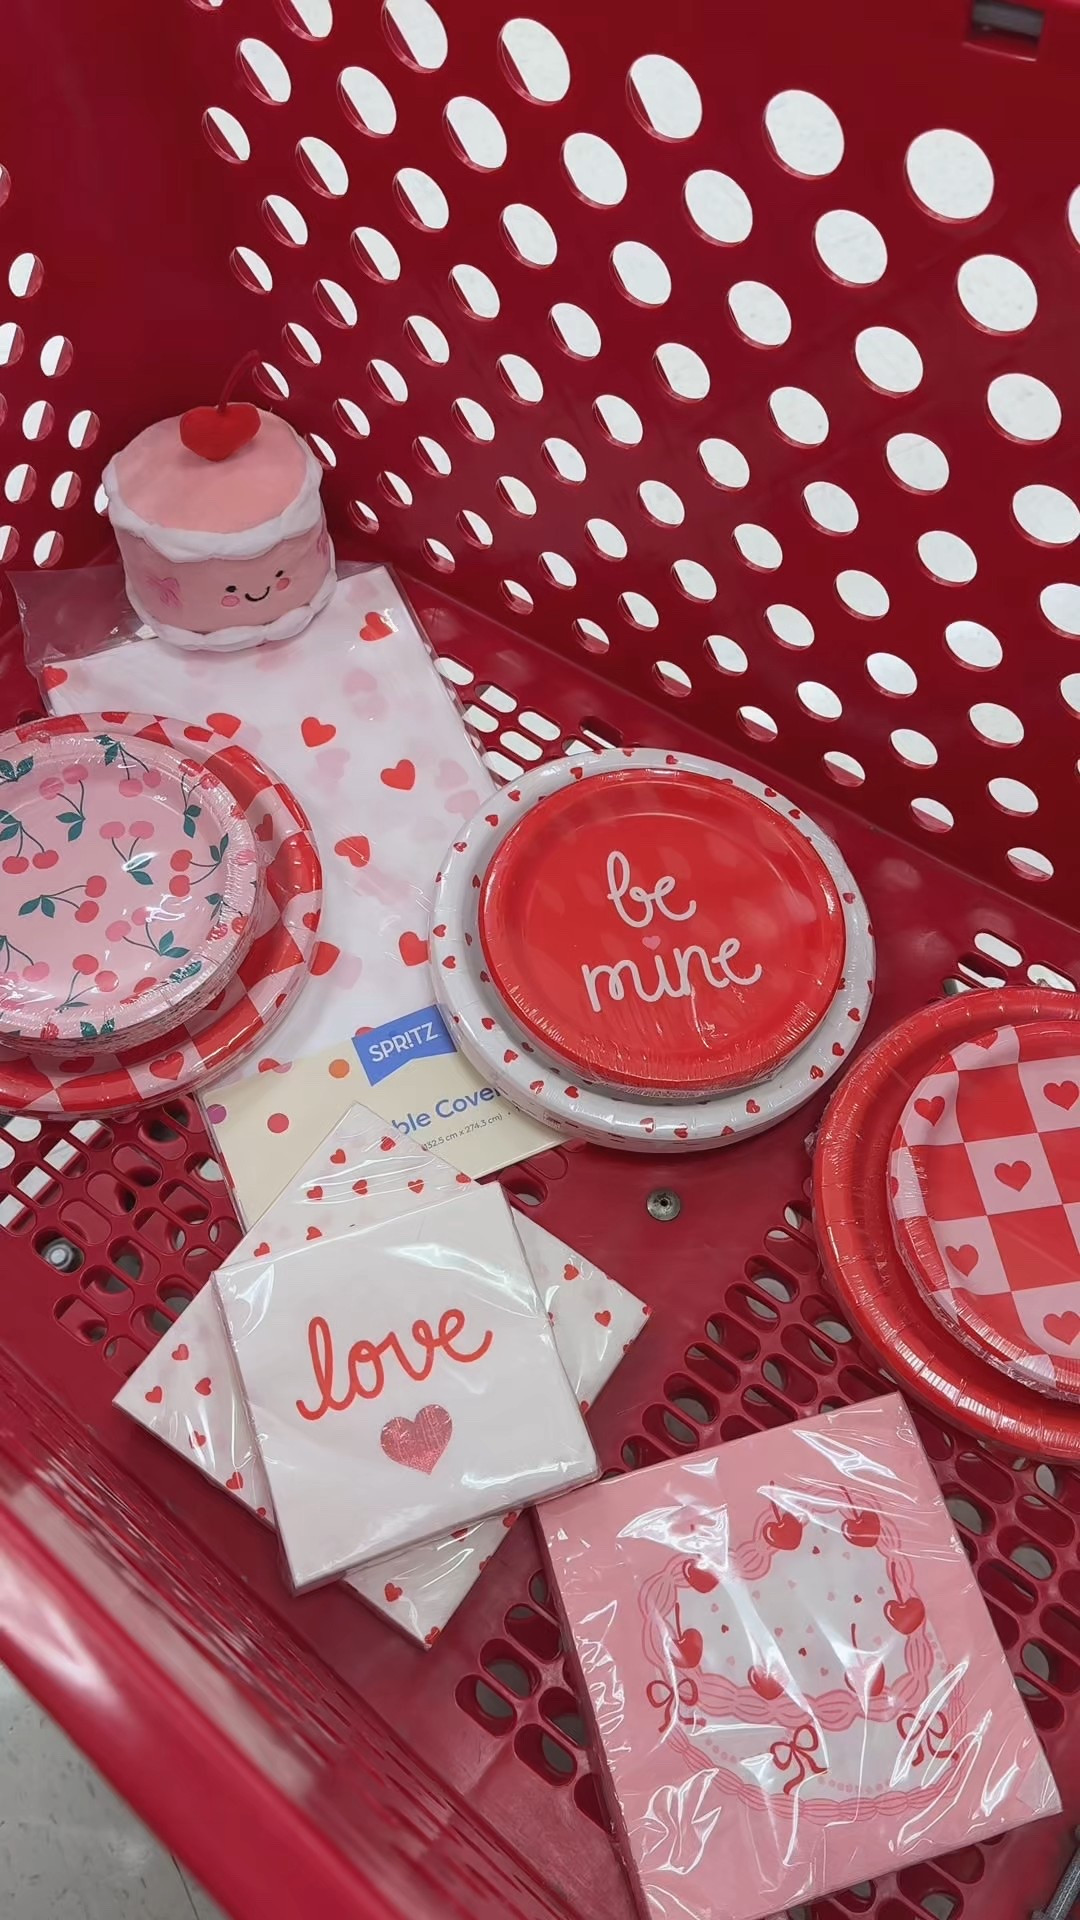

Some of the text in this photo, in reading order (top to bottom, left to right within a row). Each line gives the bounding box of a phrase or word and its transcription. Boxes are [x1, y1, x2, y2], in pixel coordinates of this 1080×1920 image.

[607, 851, 697, 928] be
[581, 937, 763, 1013] mine
[391, 1112, 432, 1135] ble
[423, 1136, 445, 1150] 132.5
[445, 1132, 458, 1142] cm
[465, 1118, 487, 1134] 274.3
[487, 1112, 503, 1125] cm)
[295, 1308, 493, 1421] love
